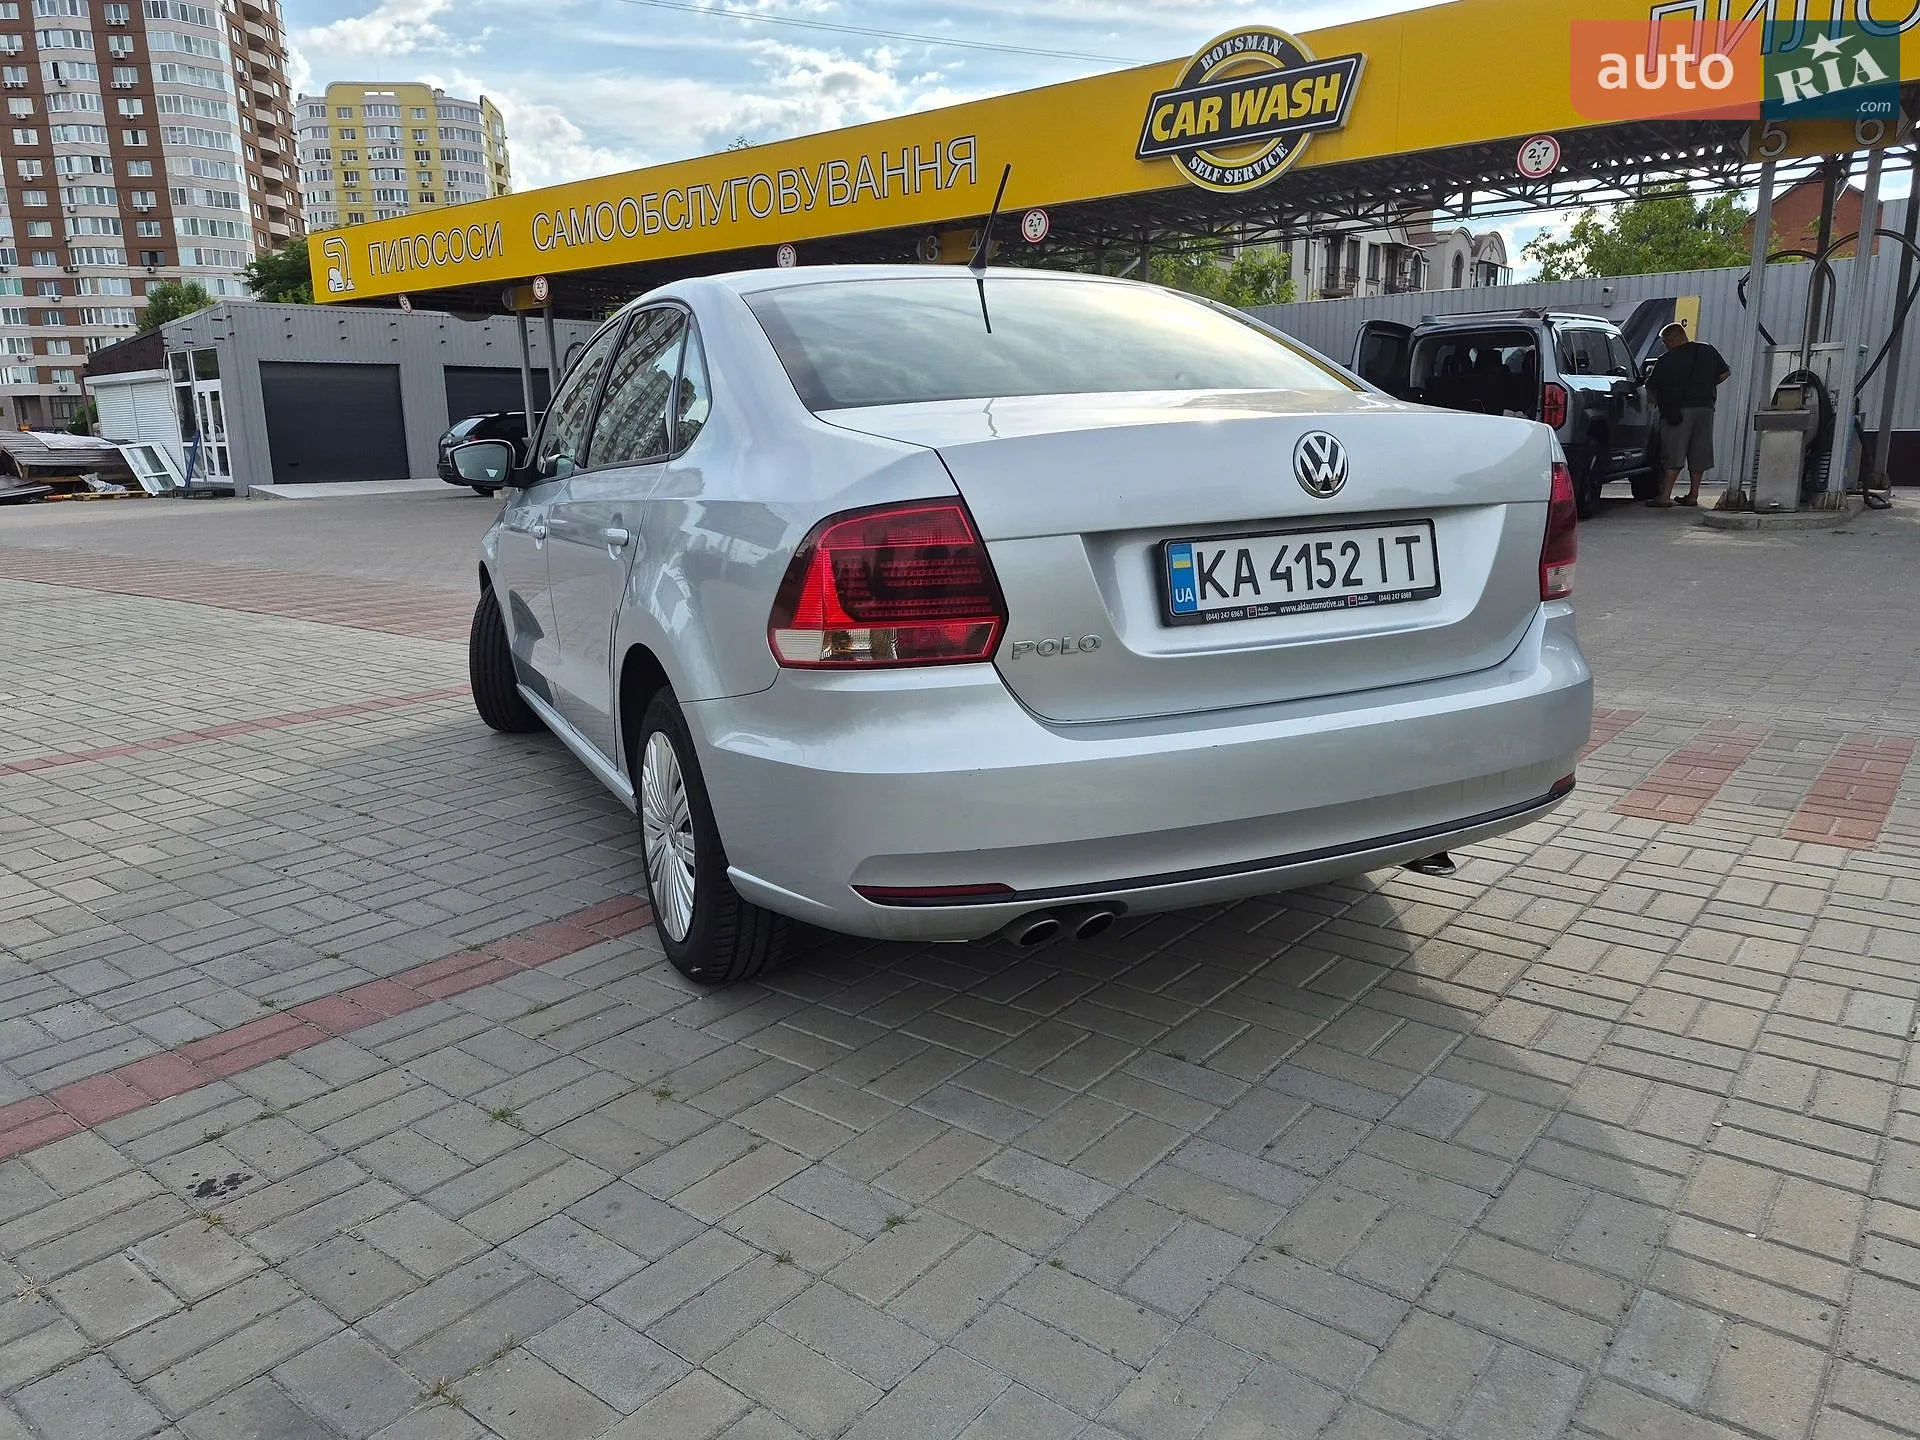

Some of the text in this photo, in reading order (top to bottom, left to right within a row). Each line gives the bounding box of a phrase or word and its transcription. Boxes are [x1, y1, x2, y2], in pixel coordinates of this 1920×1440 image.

[1200, 35, 1284, 72] BOTSMAN
[1151, 73, 1342, 142] CAR WASH
[1758, 113, 1885, 157] 5 6
[1188, 143, 1289, 184] SELF SERVICE
[1528, 147, 1550, 160] 2,7
[367, 135, 978, 277] ПИЛОСОСИ САМООБСЛУГОВУВАННЯ
[1028, 218, 1042, 228] 2,7
[926, 235, 939, 261] 3
[1197, 535, 1421, 600] KA 4152 IT
[1175, 588, 1194, 603] UA
[1280, 599, 1345, 614] www.aldautomotive.ua
[1205, 609, 1244, 621] (044) 247 6969
[1011, 634, 1102, 660] POLO
